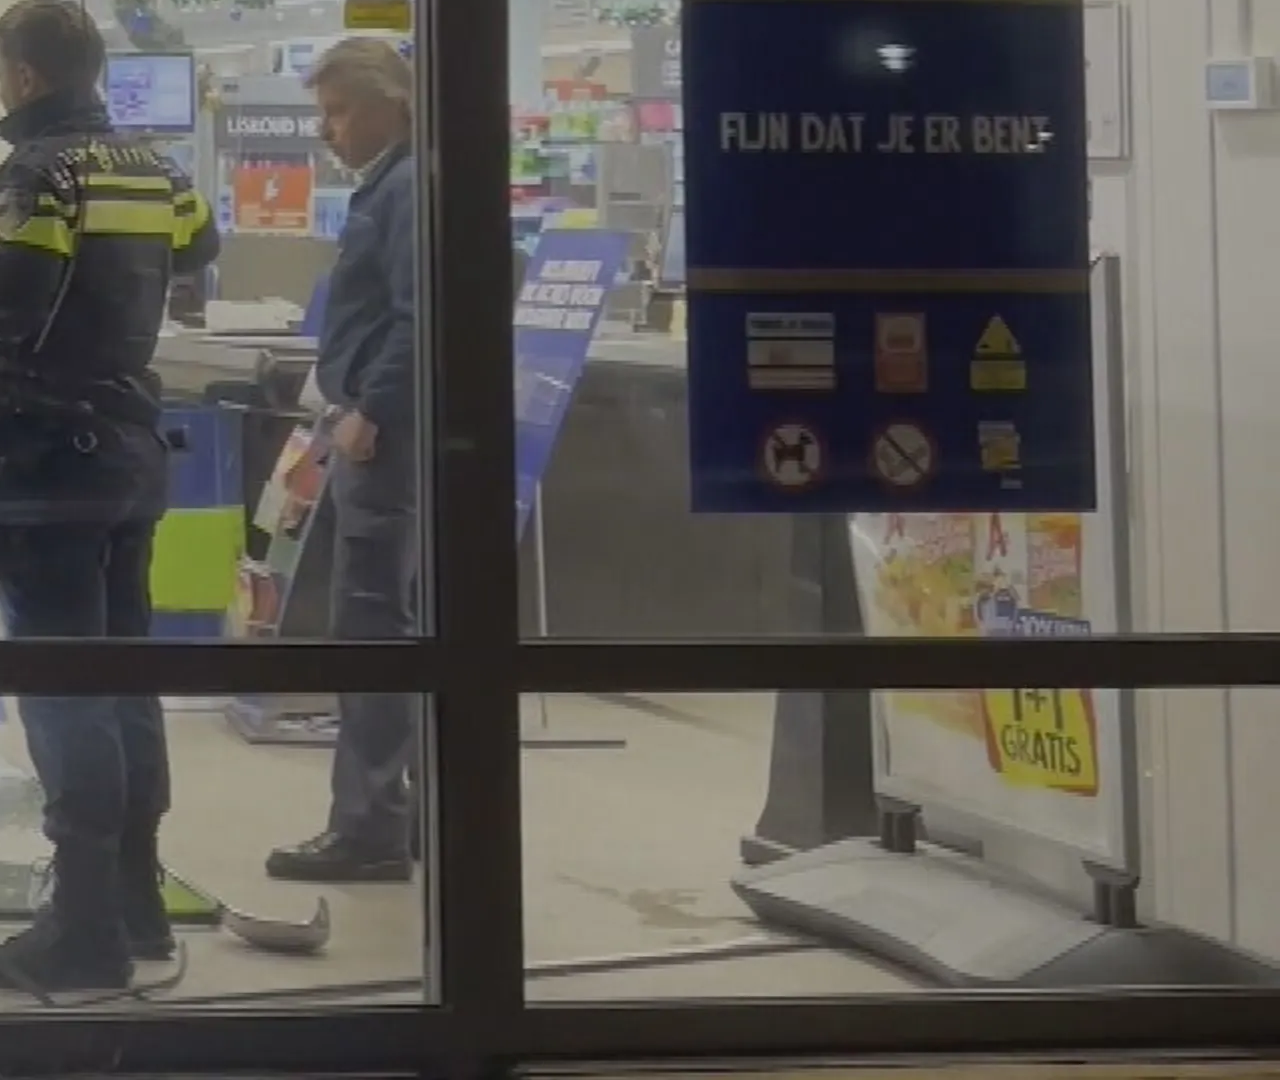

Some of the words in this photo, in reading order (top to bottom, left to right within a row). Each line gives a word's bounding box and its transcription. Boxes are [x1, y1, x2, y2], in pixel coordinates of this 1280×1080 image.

[720, 111, 789, 153] FIJN
[800, 112, 865, 153] DAT
[877, 114, 914, 153] JE
[925, 115, 961, 153] ER
[974, 115, 1050, 153] BENT
[1001, 723, 1081, 776] GRATIS
